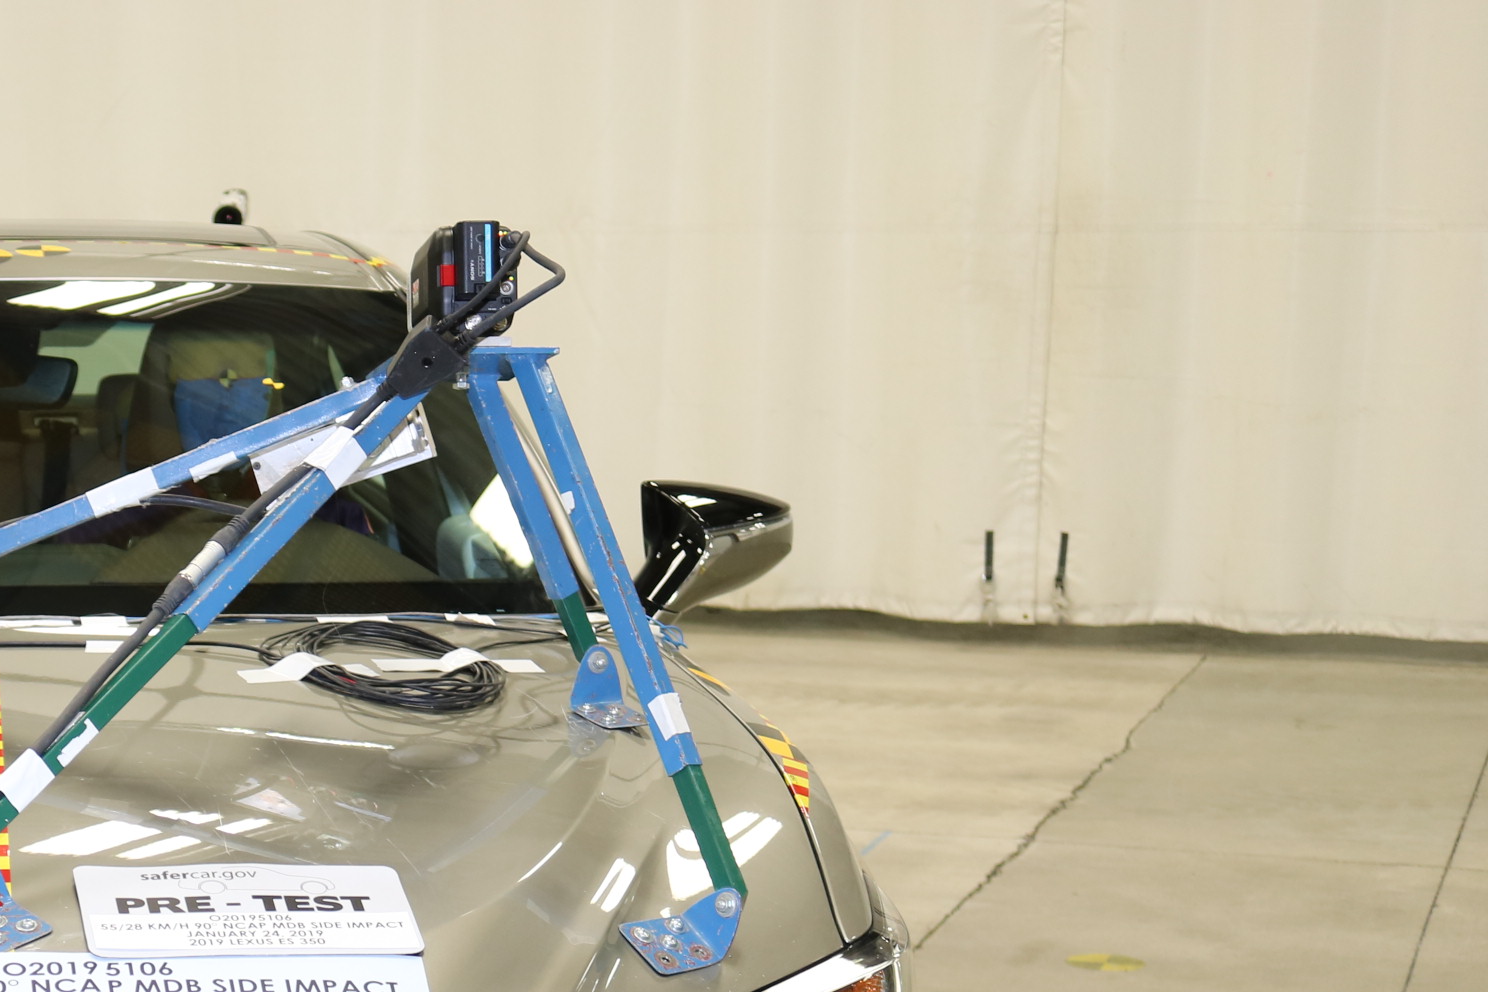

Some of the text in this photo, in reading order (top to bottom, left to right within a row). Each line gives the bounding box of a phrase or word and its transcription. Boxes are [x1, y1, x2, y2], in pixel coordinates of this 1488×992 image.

[140, 869, 257, 881] safercar.gov
[114, 894, 216, 915] PRE
[251, 894, 371, 913] TEST
[100, 922, 143, 931] 55/28
[147, 922, 190, 931] KM/H
[223, 922, 266, 930] NCAP
[272, 922, 306, 930] MDB
[311, 922, 343, 930] SIDE
[346, 921, 405, 930] IMPACT
[187, 930, 257, 938] JANUARY
[290, 930, 324, 938] 2019
[189, 938, 326, 946] 2019 LEXUS ES 350
